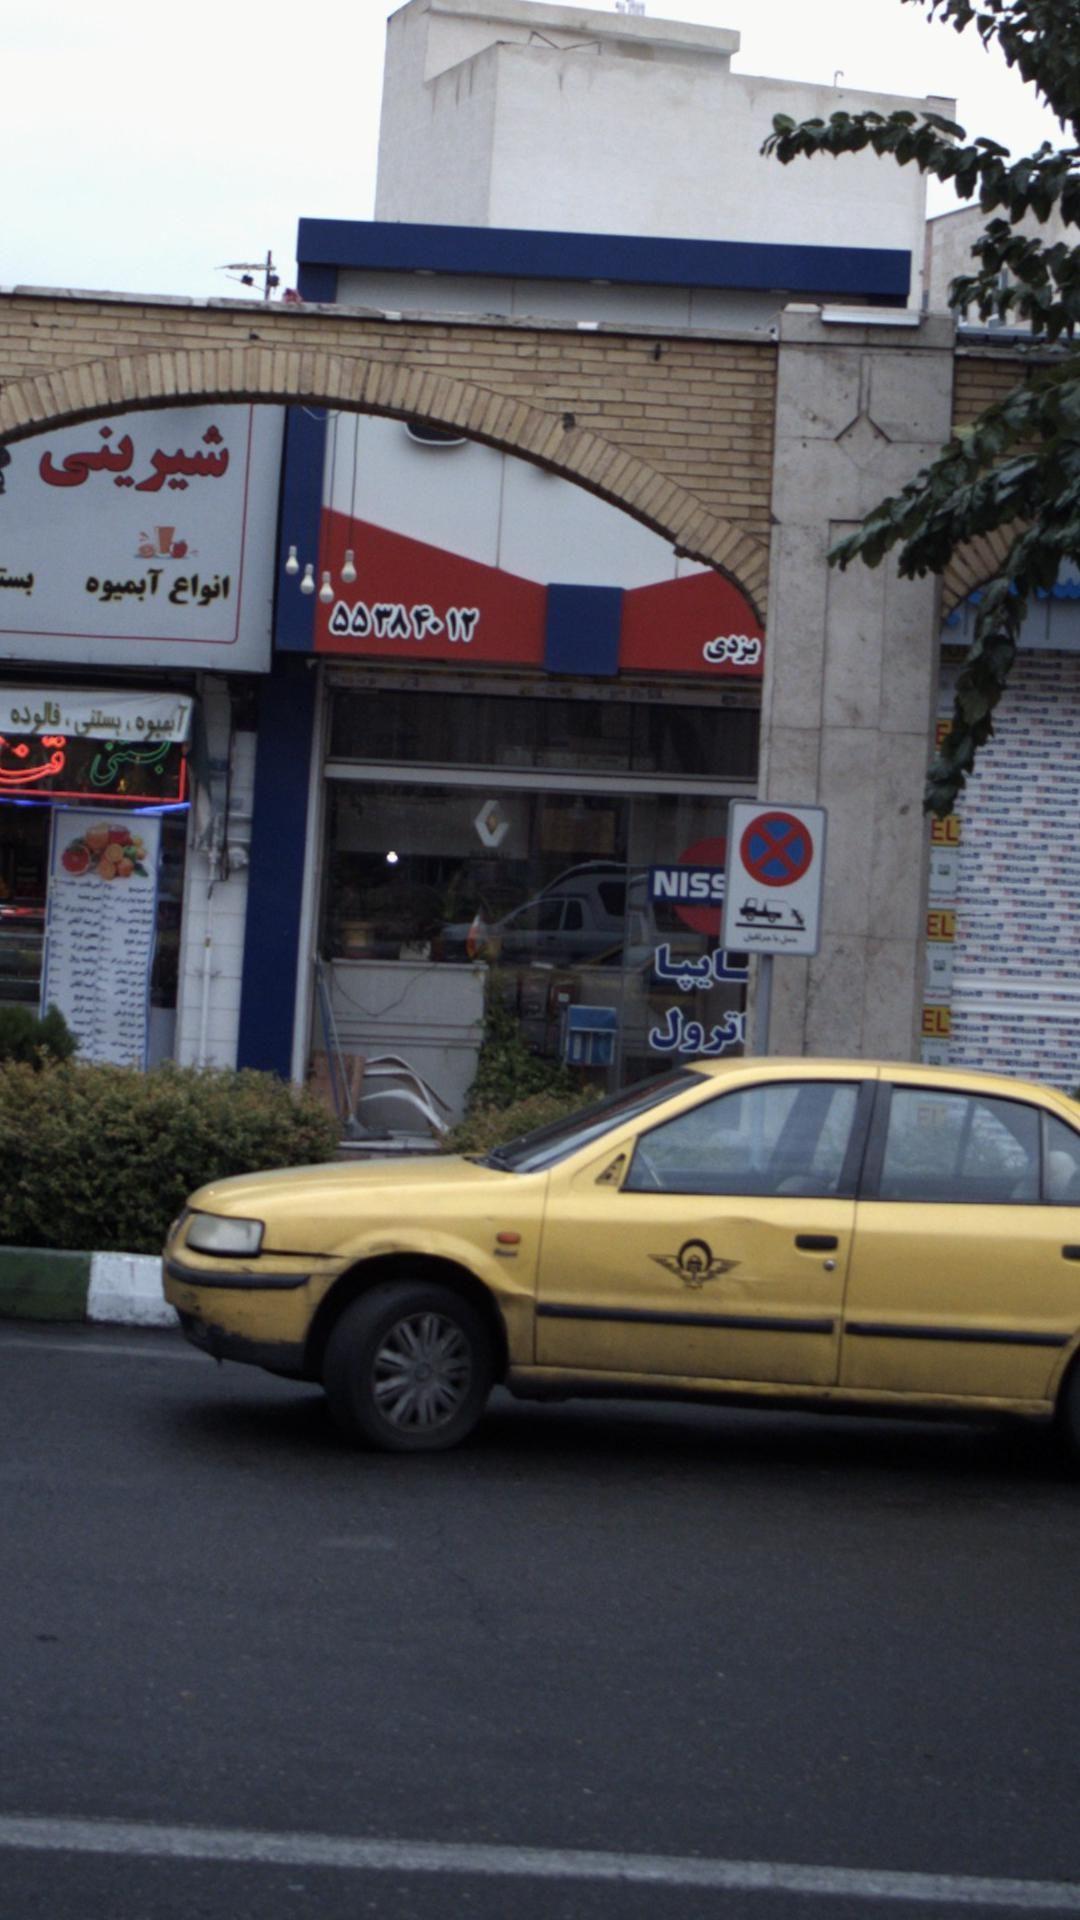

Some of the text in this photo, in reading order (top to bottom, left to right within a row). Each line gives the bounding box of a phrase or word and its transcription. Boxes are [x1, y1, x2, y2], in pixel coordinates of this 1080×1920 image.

[38, 424, 229, 492] شیرینی
[0, 567, 34, 597] بست
[85, 568, 230, 606] انواع آبمیوه
[703, 634, 761, 665] یزدی
[931, 817, 960, 841] EL
[653, 870, 725, 900] NISS
[927, 914, 955, 937] EL
[655, 943, 748, 990] ایپا
[649, 1006, 746, 1053] اترول
[922, 1009, 951, 1034] EL
